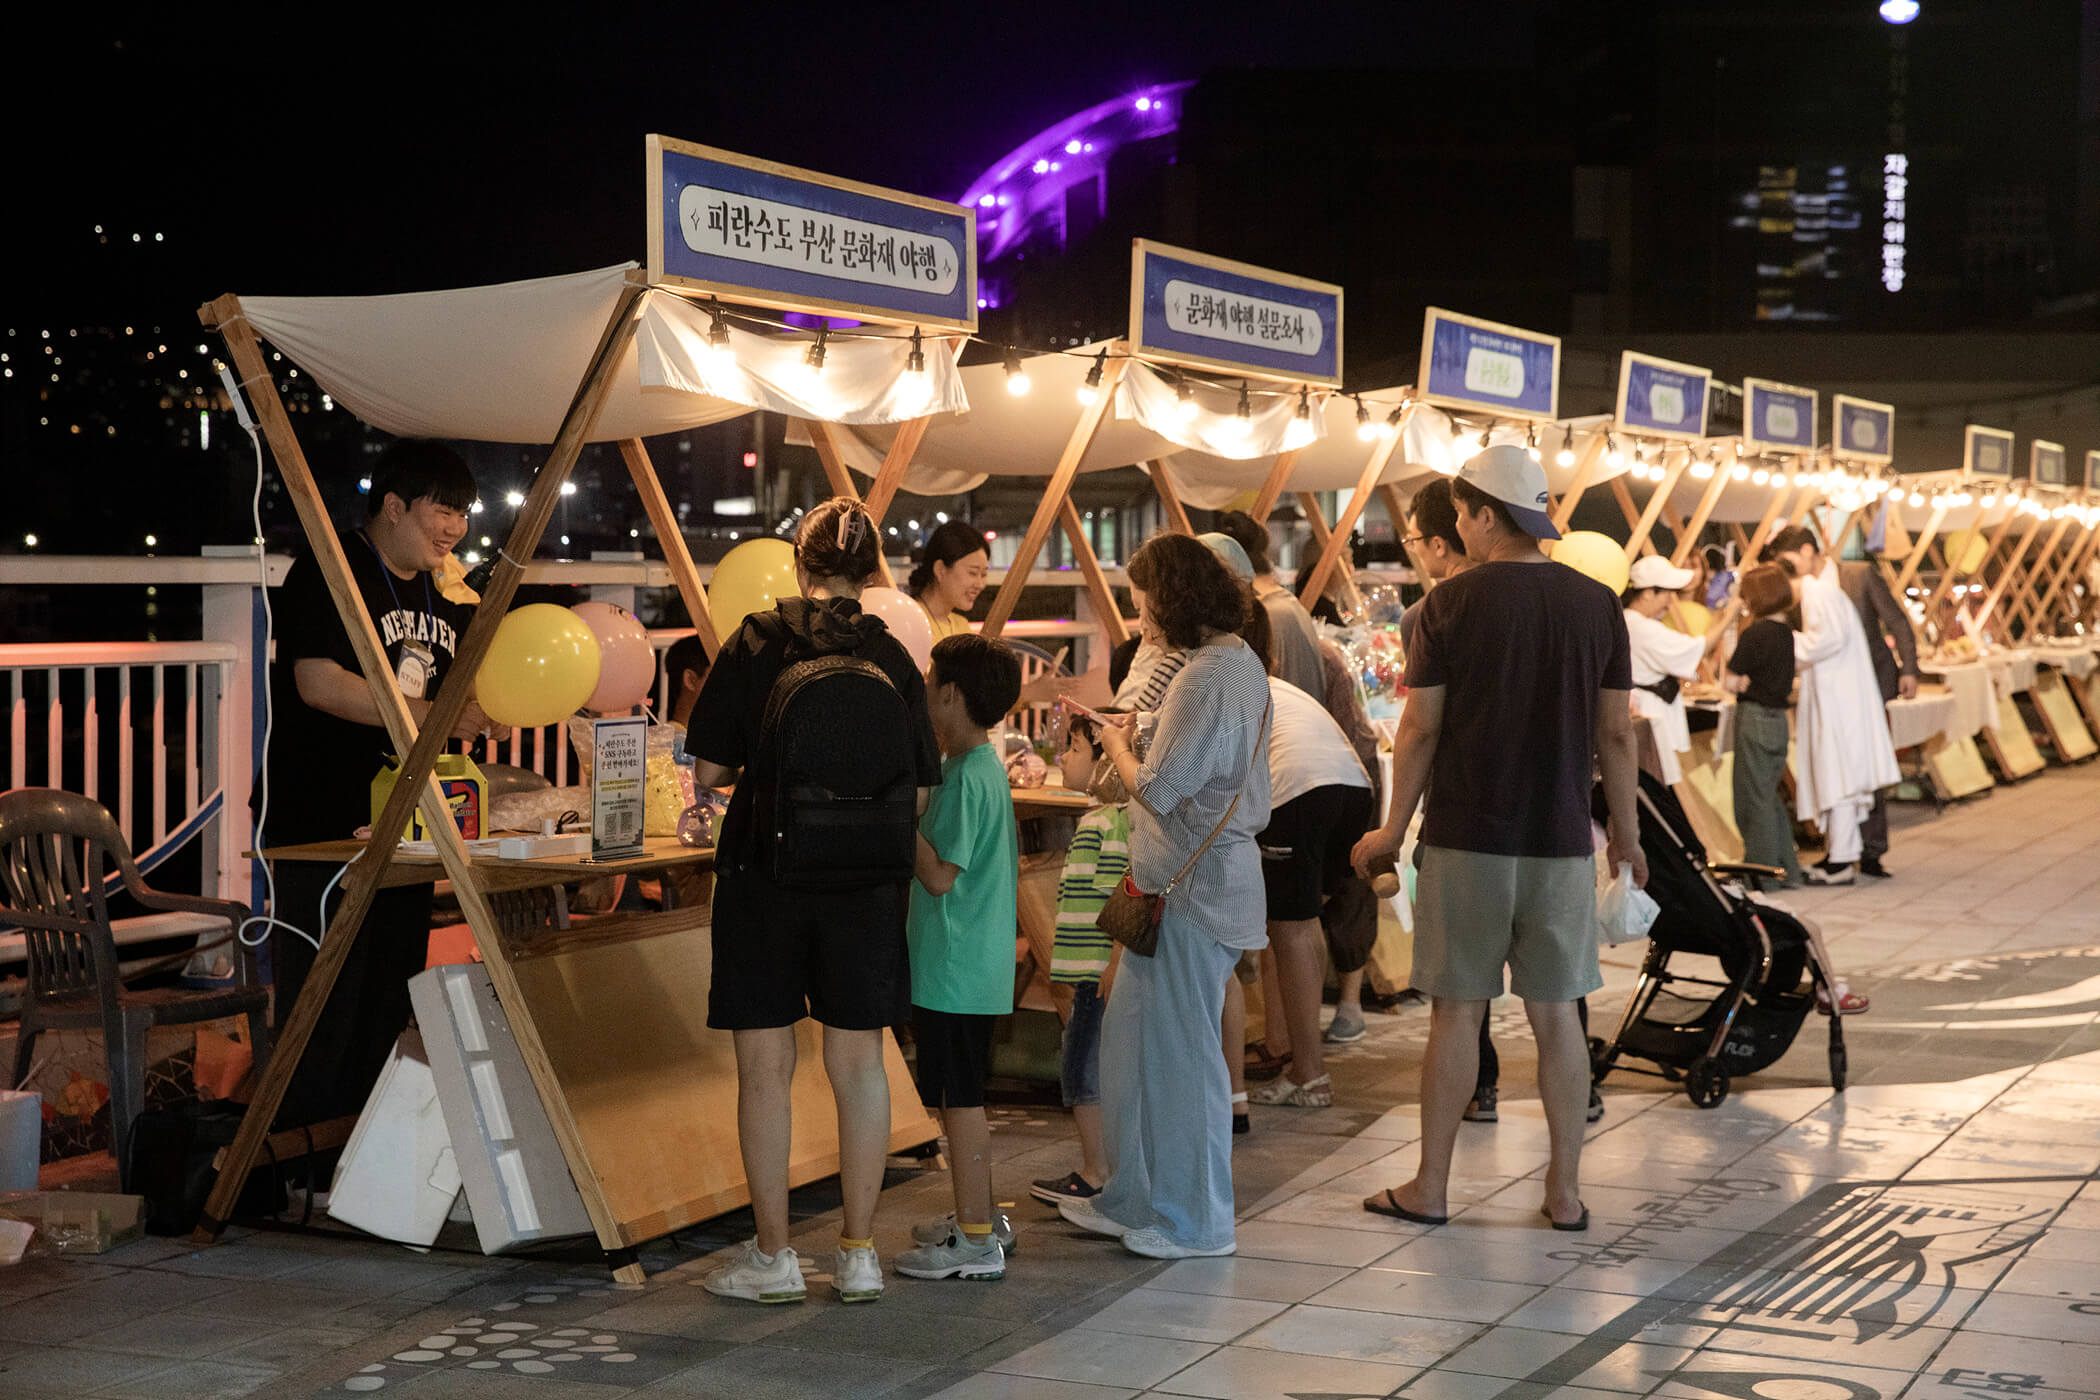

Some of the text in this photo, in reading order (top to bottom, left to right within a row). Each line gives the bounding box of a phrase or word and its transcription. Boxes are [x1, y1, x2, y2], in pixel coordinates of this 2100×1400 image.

[707, 201, 938, 282] 피란수도 부산 문화재 야행
[1186, 292, 1304, 345] 문화재 야행 설문조사
[400, 672, 421, 688] STAFF
[604, 750, 616, 758] SNS
[1546, 1189, 1741, 1268] 자갈치시장
